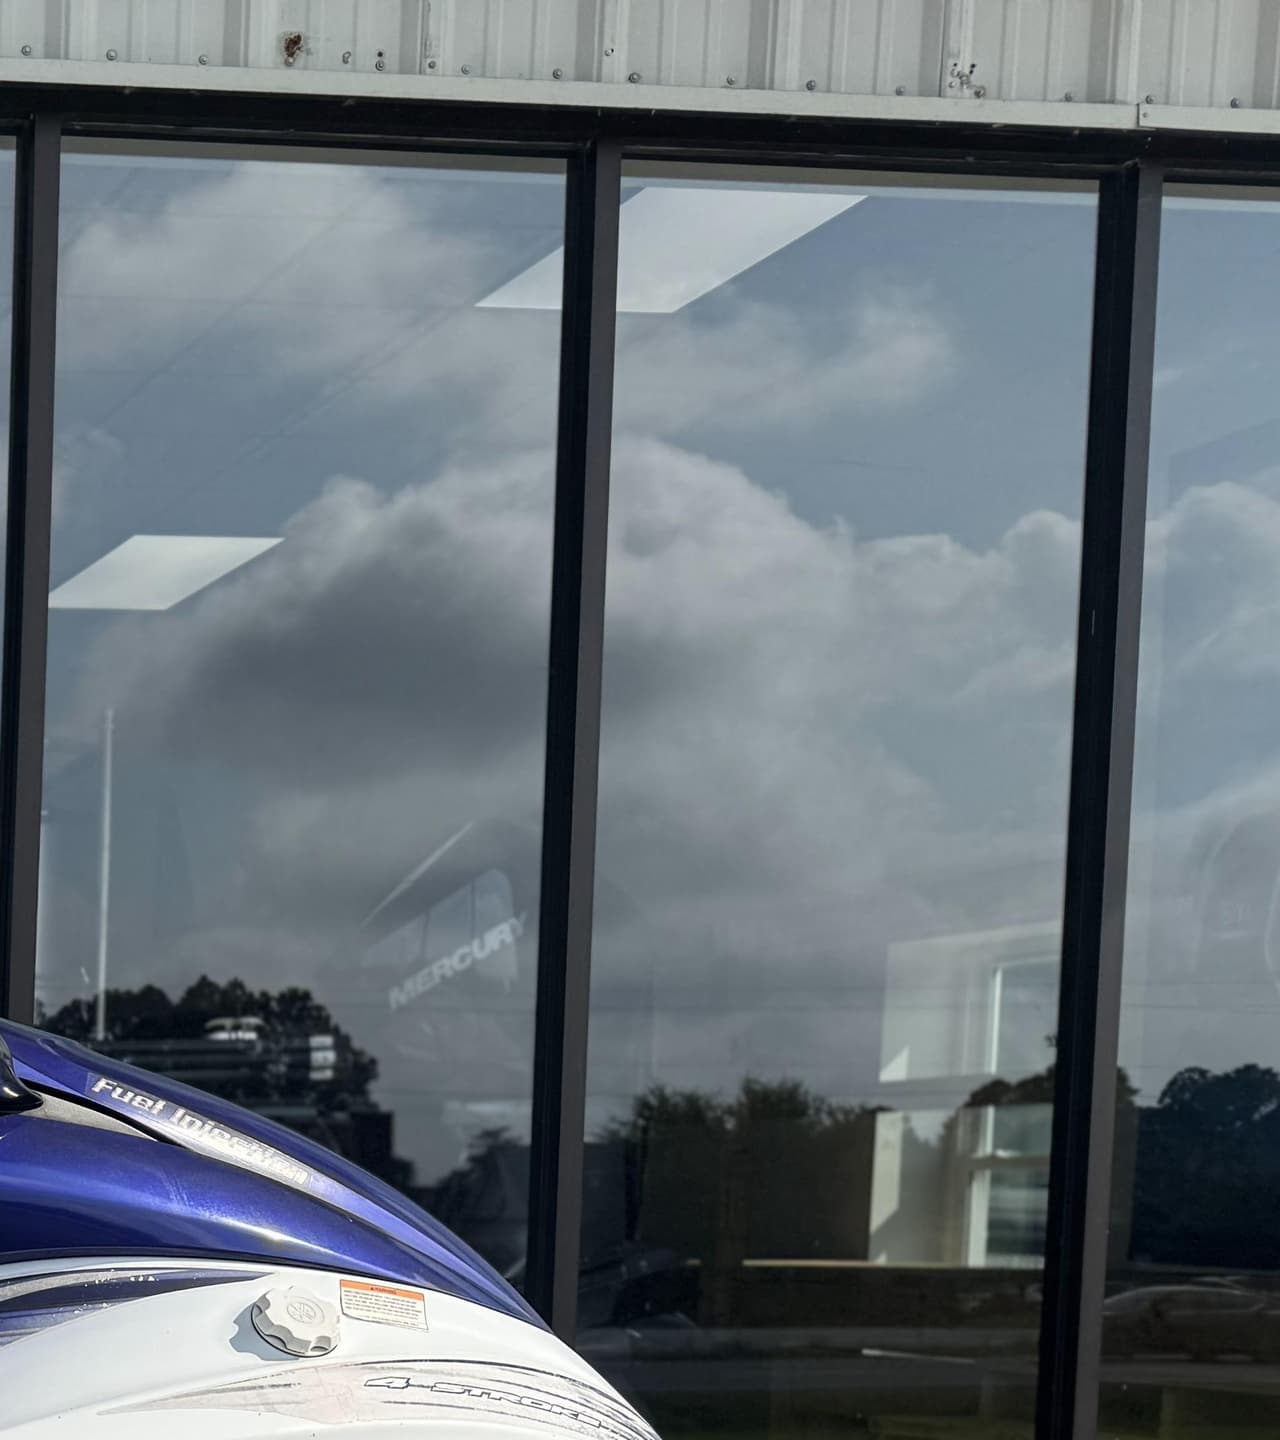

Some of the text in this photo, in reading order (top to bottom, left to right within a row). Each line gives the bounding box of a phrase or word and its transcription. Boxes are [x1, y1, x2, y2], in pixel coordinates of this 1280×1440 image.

[389, 910, 528, 1011] MERCURY
[91, 1077, 310, 1186] Fuel Injection
